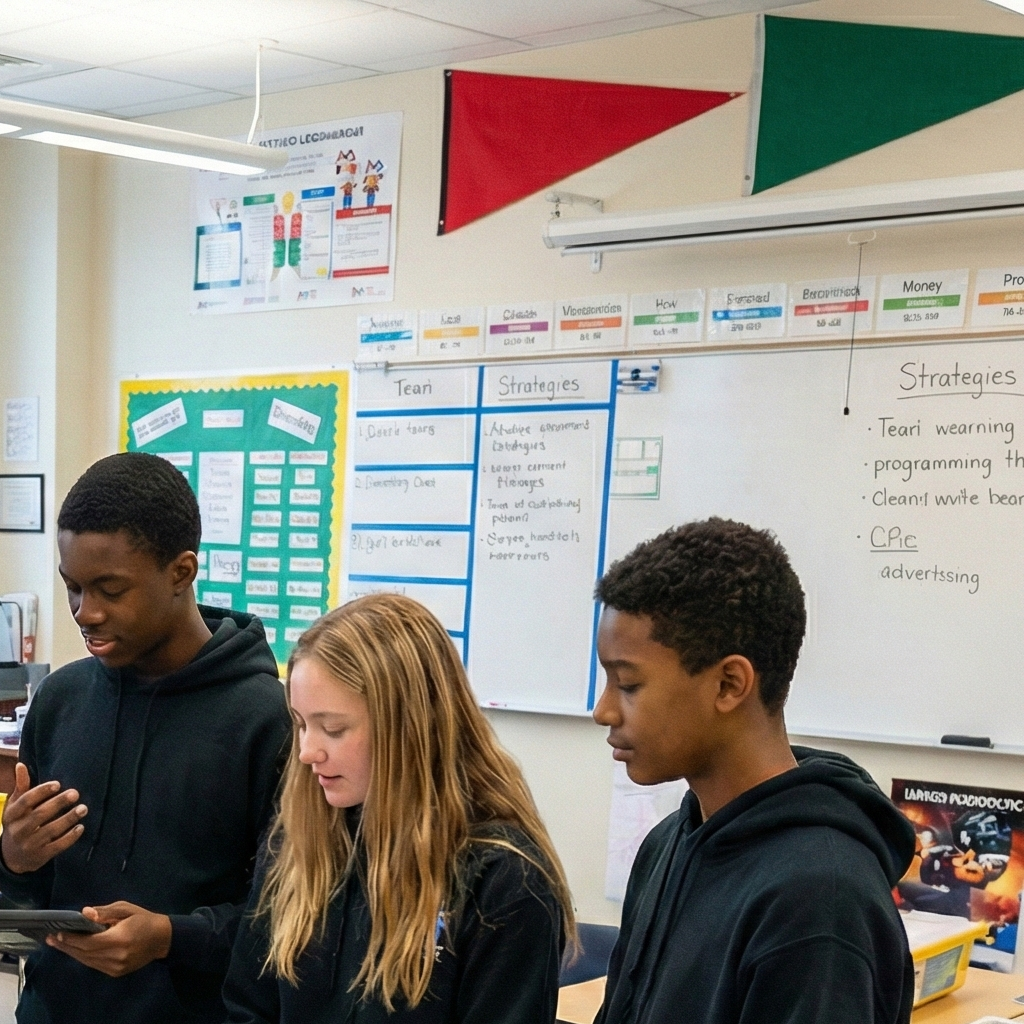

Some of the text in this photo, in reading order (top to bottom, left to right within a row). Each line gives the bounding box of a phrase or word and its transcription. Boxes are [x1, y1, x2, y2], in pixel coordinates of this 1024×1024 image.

[902, 280, 943, 295] Money
[1003, 273, 1024, 287] Pro
[498, 375, 580, 400] Strategies
[899, 362, 1017, 399] Strategies
[936, 418, 1015, 444] wearning
[874, 452, 992, 483] programming
